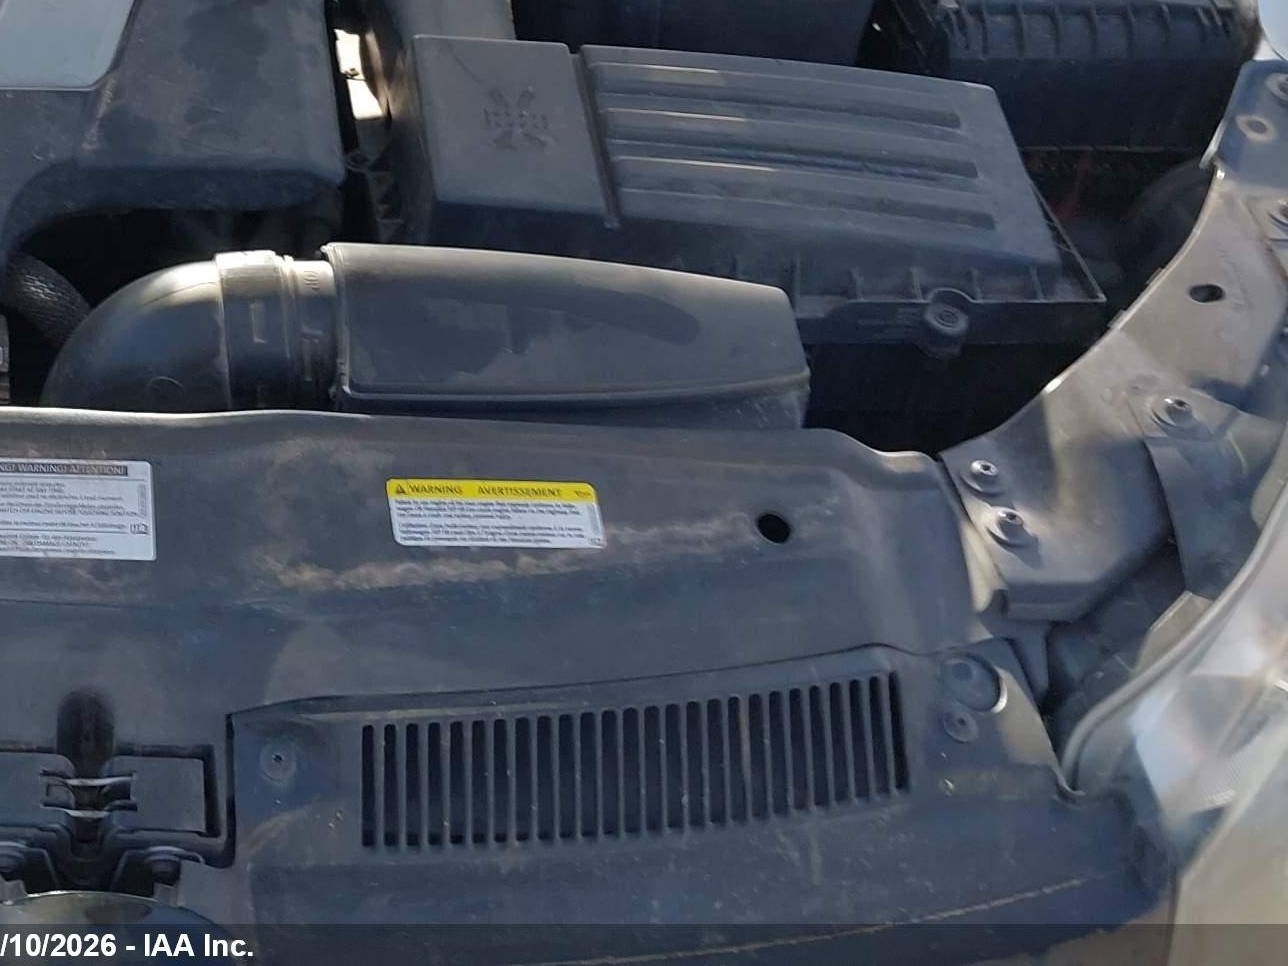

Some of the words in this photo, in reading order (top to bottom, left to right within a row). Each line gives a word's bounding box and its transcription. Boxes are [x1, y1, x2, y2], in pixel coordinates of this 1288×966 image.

[18, 463, 67, 474] WARNING!
[409, 484, 463, 494] WARNING
[478, 485, 561, 497] AVERTISSEMENT
